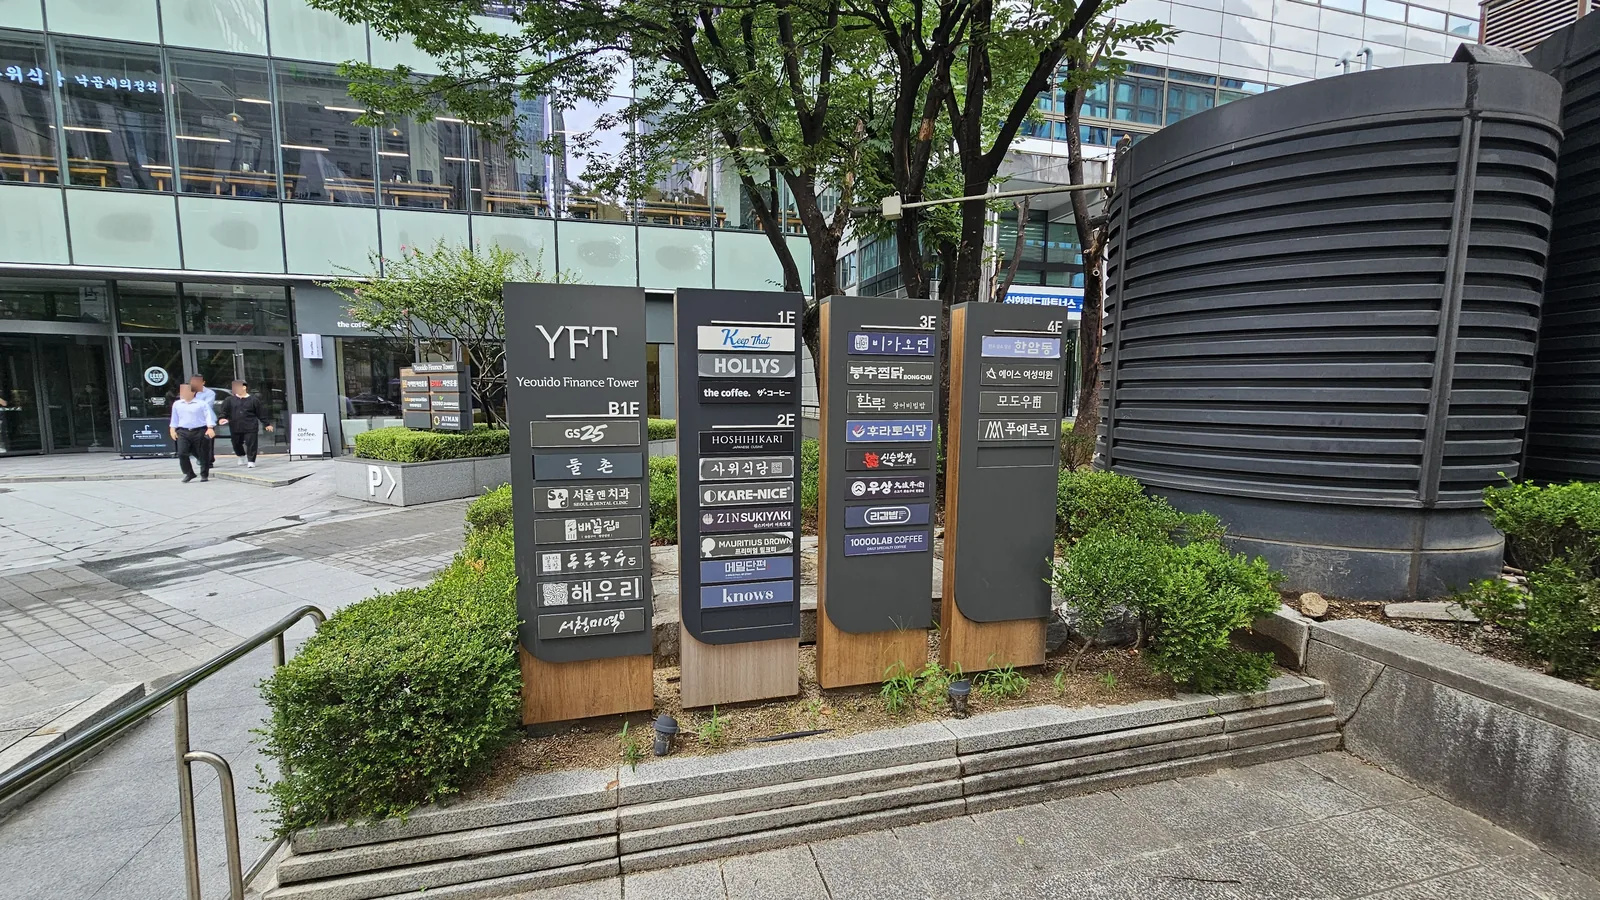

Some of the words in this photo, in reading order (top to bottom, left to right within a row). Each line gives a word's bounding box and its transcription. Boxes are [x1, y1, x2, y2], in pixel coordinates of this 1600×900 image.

[777, 311, 796, 324] 1F
[919, 315, 937, 329] 3F
[1046, 320, 1064, 333] 4F
[535, 325, 618, 360] YFT
[721, 328, 750, 349] Keep
[751, 333, 772, 347] That
[1014, 340, 1053, 355] 한암동
[714, 357, 780, 374] HOLLYS
[849, 366, 905, 380] 봉추찜닭
[998, 369, 1022, 379] 에이스
[1023, 369, 1054, 380] 여성의원
[516, 376, 561, 388] Yeouido
[563, 376, 605, 388] Finance
[606, 377, 639, 388] Tower
[703, 388, 720, 397] the
[721, 388, 751, 397] coffee.
[608, 401, 640, 415] B1F
[996, 395, 1032, 409] 모도우
[776, 413, 796, 427] 2F
[564, 424, 608, 442] GS25
[866, 424, 927, 437] 후라토식당
[1004, 421, 1050, 437] 푸에르코
[712, 435, 784, 445] HOSHIHIKARI
[710, 460, 769, 477] 사위식당
[368, 464, 383, 496] P
[717, 488, 788, 501] KARE-NICE
[867, 480, 893, 495] 우상
[718, 538, 763, 548] MAURITIUS
[764, 536, 792, 546] BROWN
[850, 536, 893, 547] 10000LAB
[893, 534, 923, 544] COFFEE
[724, 559, 766, 573] 메밀단편
[571, 577, 639, 602] 해우리
[722, 588, 774, 604] knows
